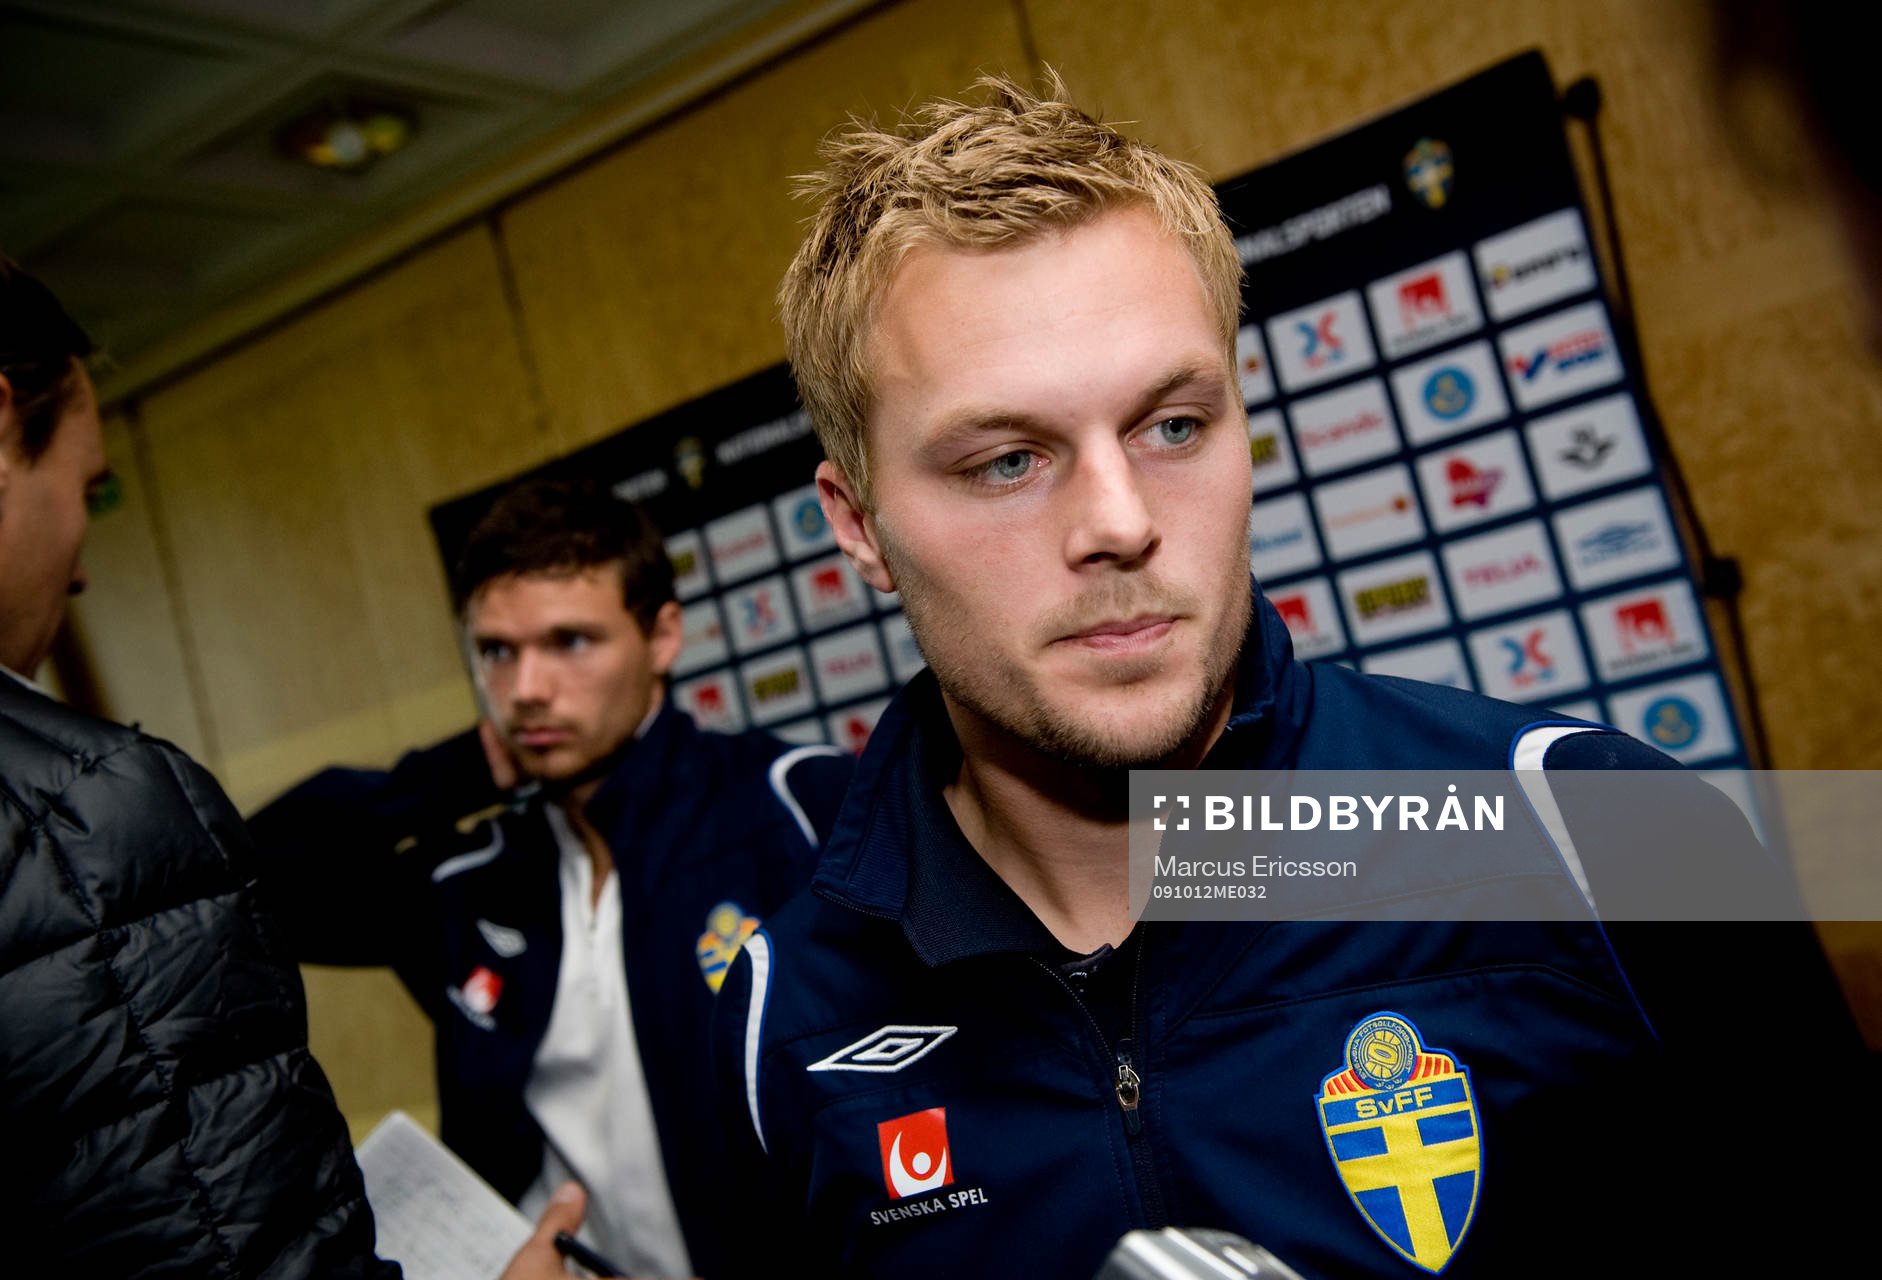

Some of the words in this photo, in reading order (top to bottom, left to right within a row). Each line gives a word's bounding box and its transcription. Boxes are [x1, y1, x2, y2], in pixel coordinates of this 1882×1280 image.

[1355, 1086, 1434, 1120] SvFF
[870, 1198, 948, 1226] SVENSKA
[948, 1188, 989, 1209] SPEL
